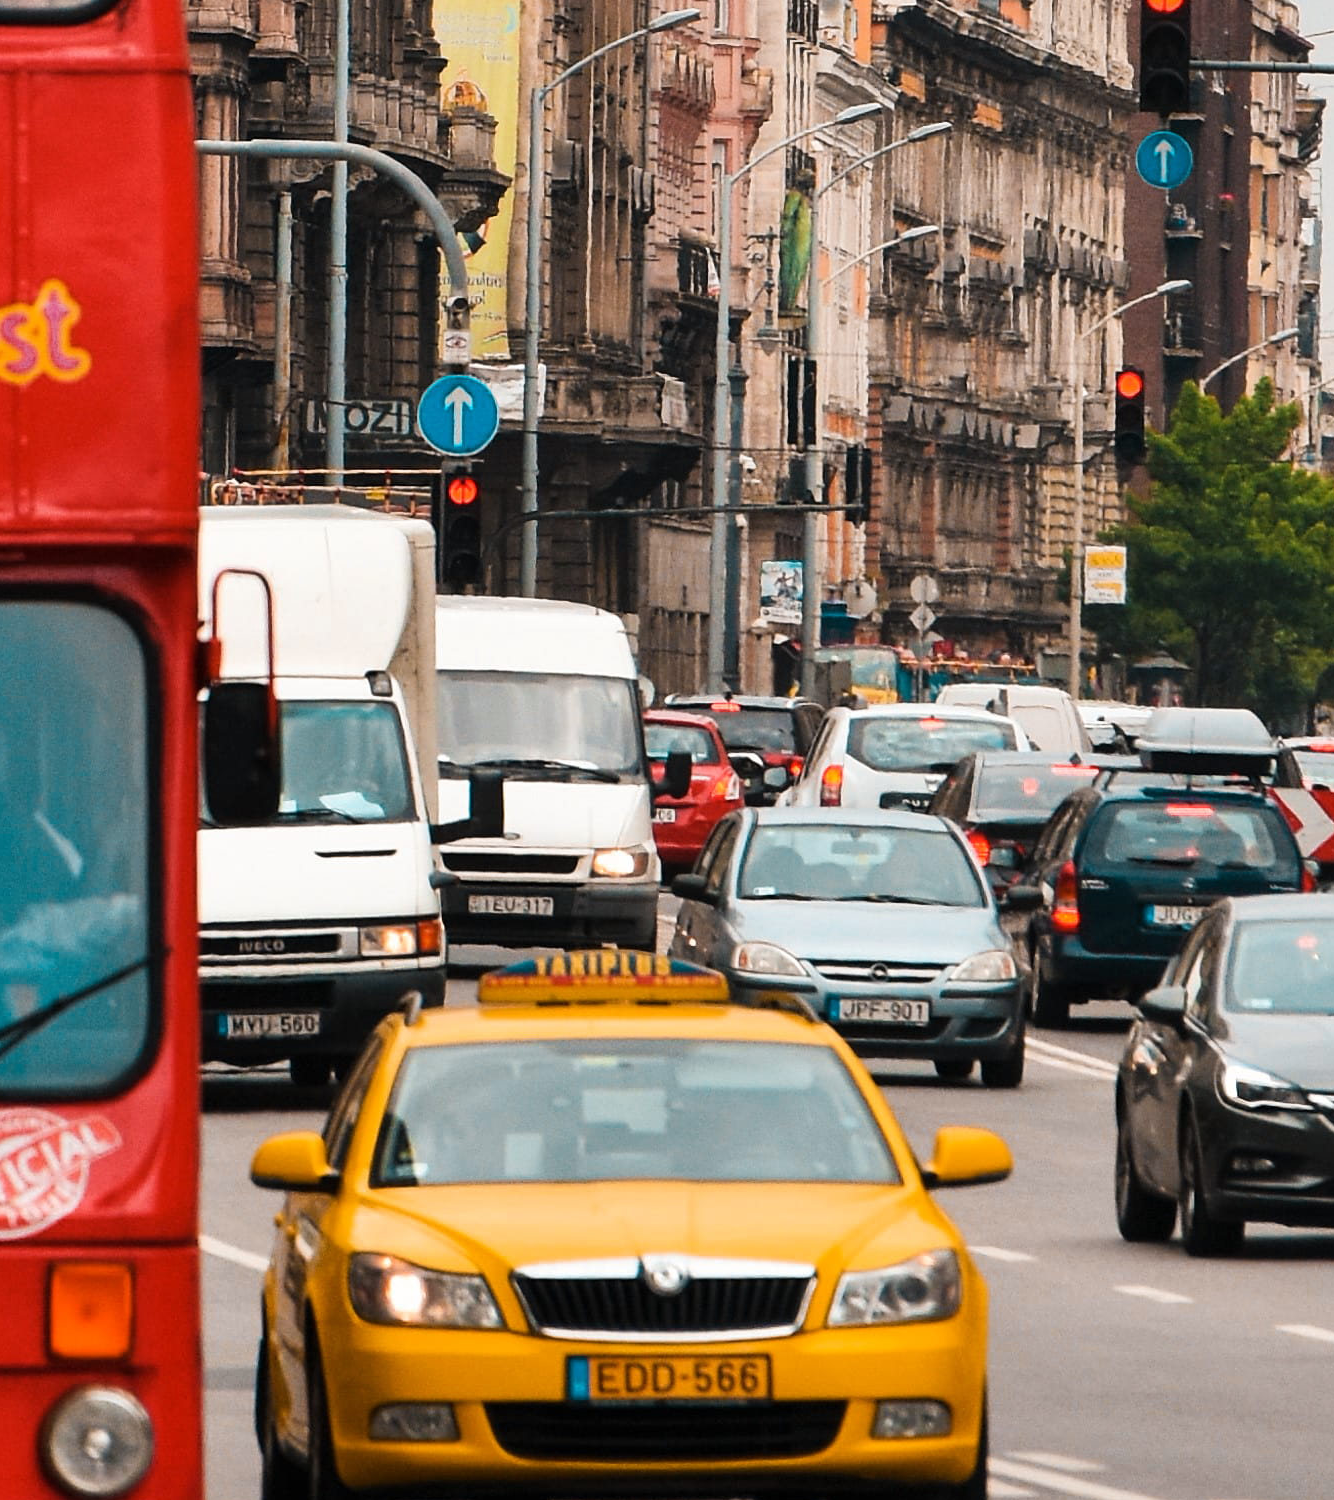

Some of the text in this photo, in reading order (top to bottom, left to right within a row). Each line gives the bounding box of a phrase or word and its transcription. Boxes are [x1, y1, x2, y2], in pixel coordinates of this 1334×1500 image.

[239, 939, 285, 953] IVECO
[842, 1000, 924, 1020] JPF-901
[597, 1361, 759, 1394] EDD-566
